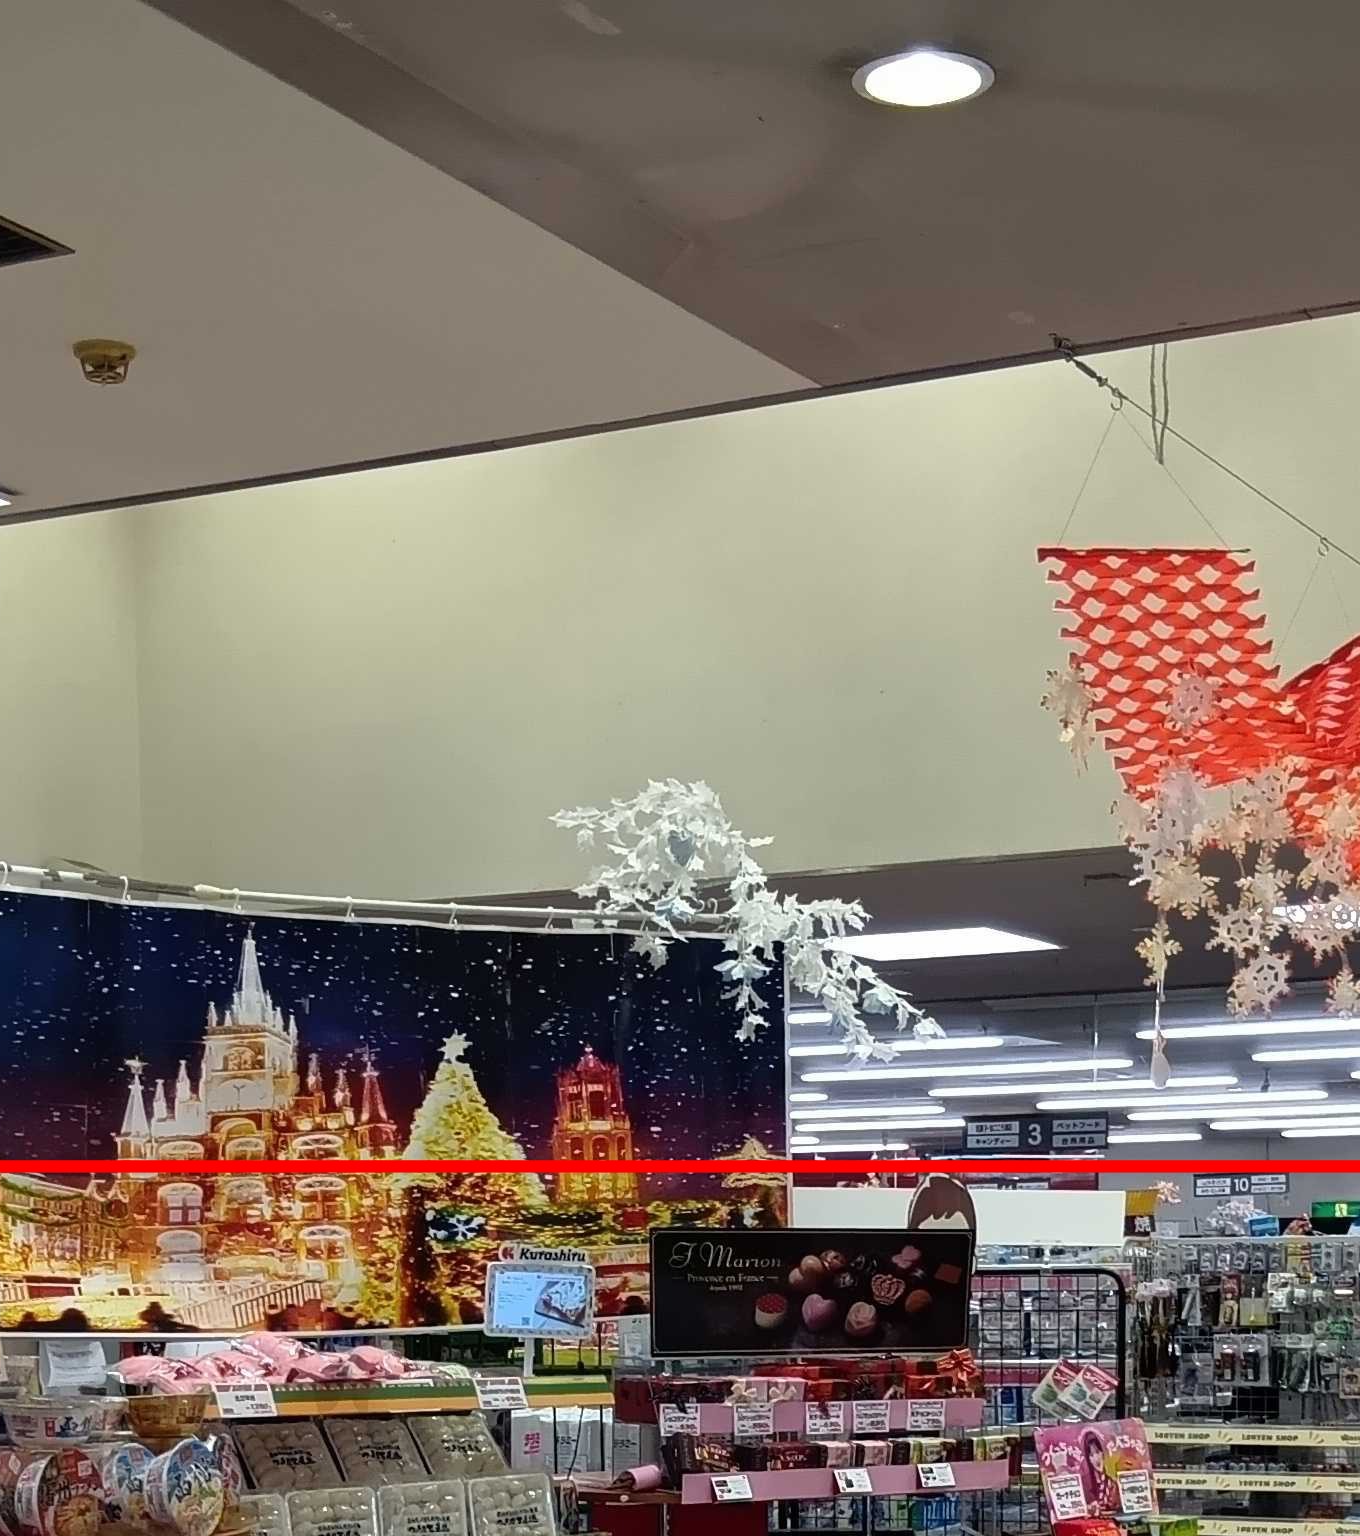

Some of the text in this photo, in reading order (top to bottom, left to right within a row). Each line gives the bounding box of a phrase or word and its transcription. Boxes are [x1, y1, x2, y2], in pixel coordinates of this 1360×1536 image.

[1027, 1123, 1042, 1145] 3
[1233, 1177, 1249, 1192] 10
[520, 1247, 586, 1261] Kurashiru
